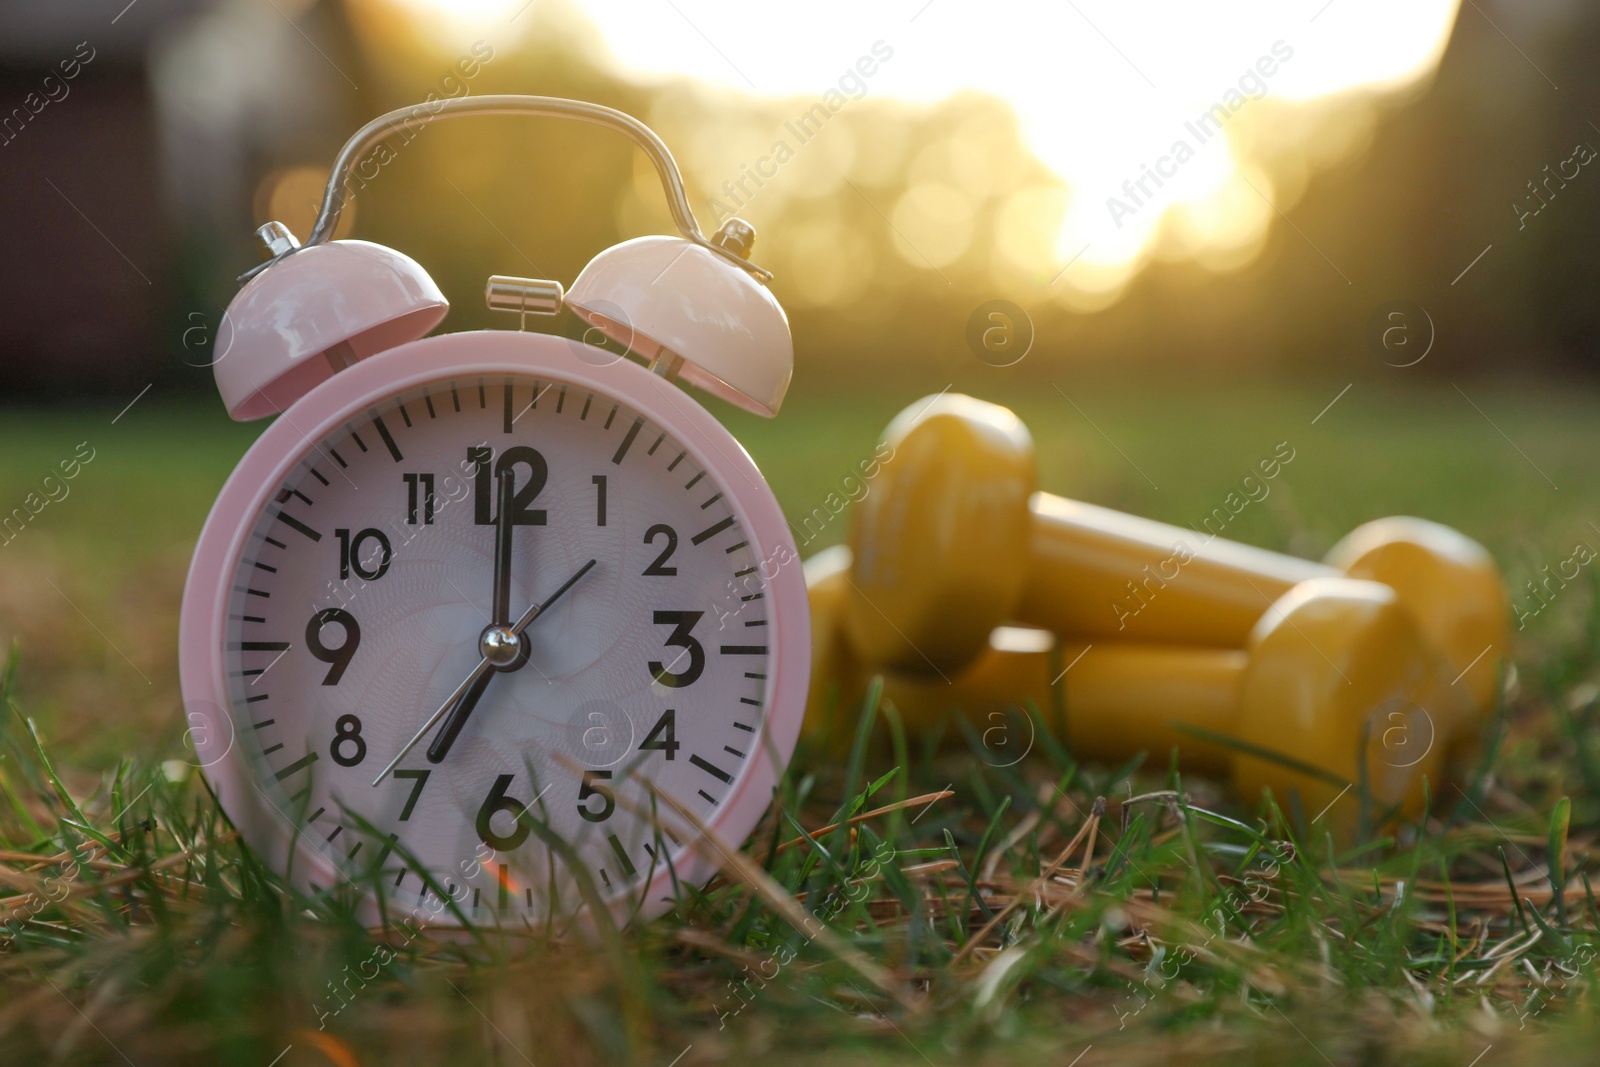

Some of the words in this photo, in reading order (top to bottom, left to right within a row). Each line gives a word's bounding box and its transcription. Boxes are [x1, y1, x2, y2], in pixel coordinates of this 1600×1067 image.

[403, 473, 434, 525] 11
[467, 446, 548, 526] 12
[592, 475, 607, 526] 1
[335, 528, 392, 581] 10
[641, 524, 678, 577] 2
[305, 607, 361, 686] 9
[647, 610, 706, 688] 3
[330, 714, 367, 767] 8
[638, 709, 680, 761] 4
[393, 769, 431, 821] 7
[475, 774, 531, 852] 6
[576, 770, 616, 822] 5
